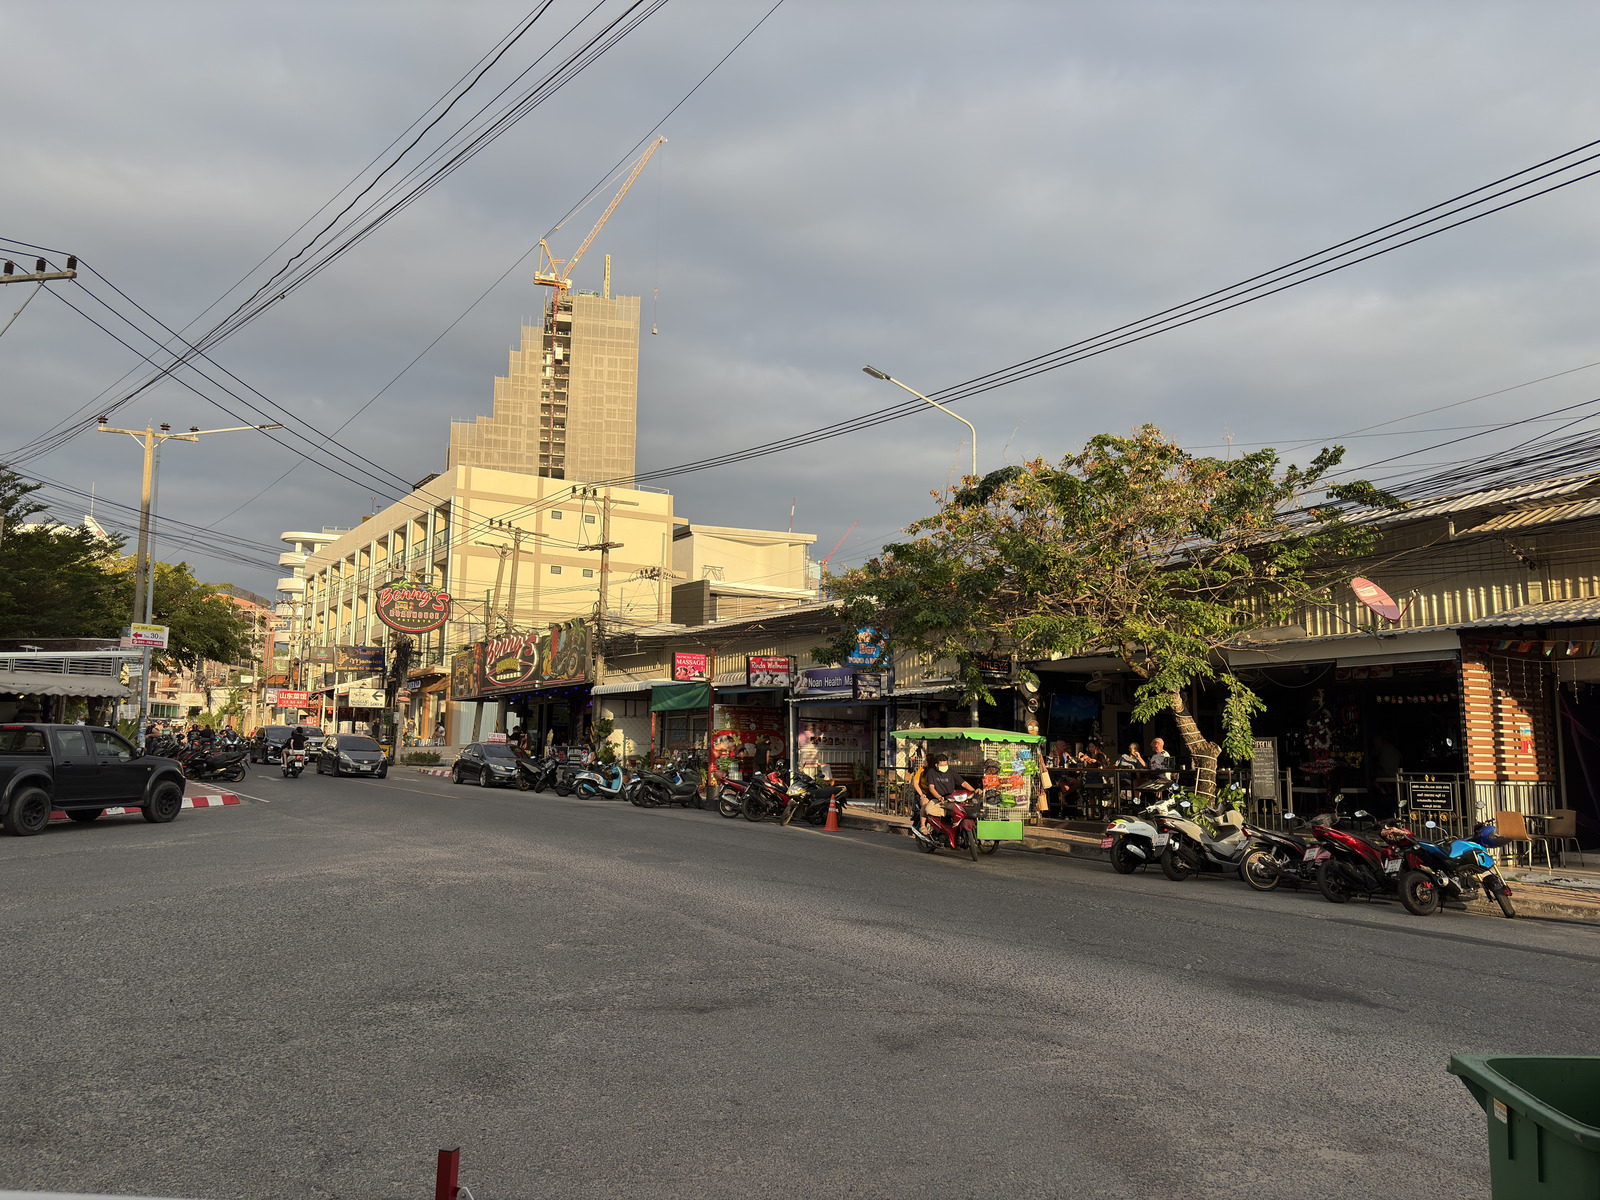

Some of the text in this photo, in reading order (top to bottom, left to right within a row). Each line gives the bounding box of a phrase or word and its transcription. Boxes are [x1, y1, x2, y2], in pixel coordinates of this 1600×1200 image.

[390, 609, 439, 620] ROADHOUSE
[859, 643, 876, 654] Bar
[676, 659, 704, 667] MASSAGE
[808, 677, 823, 688] Noan
[824, 676, 842, 687] Health
